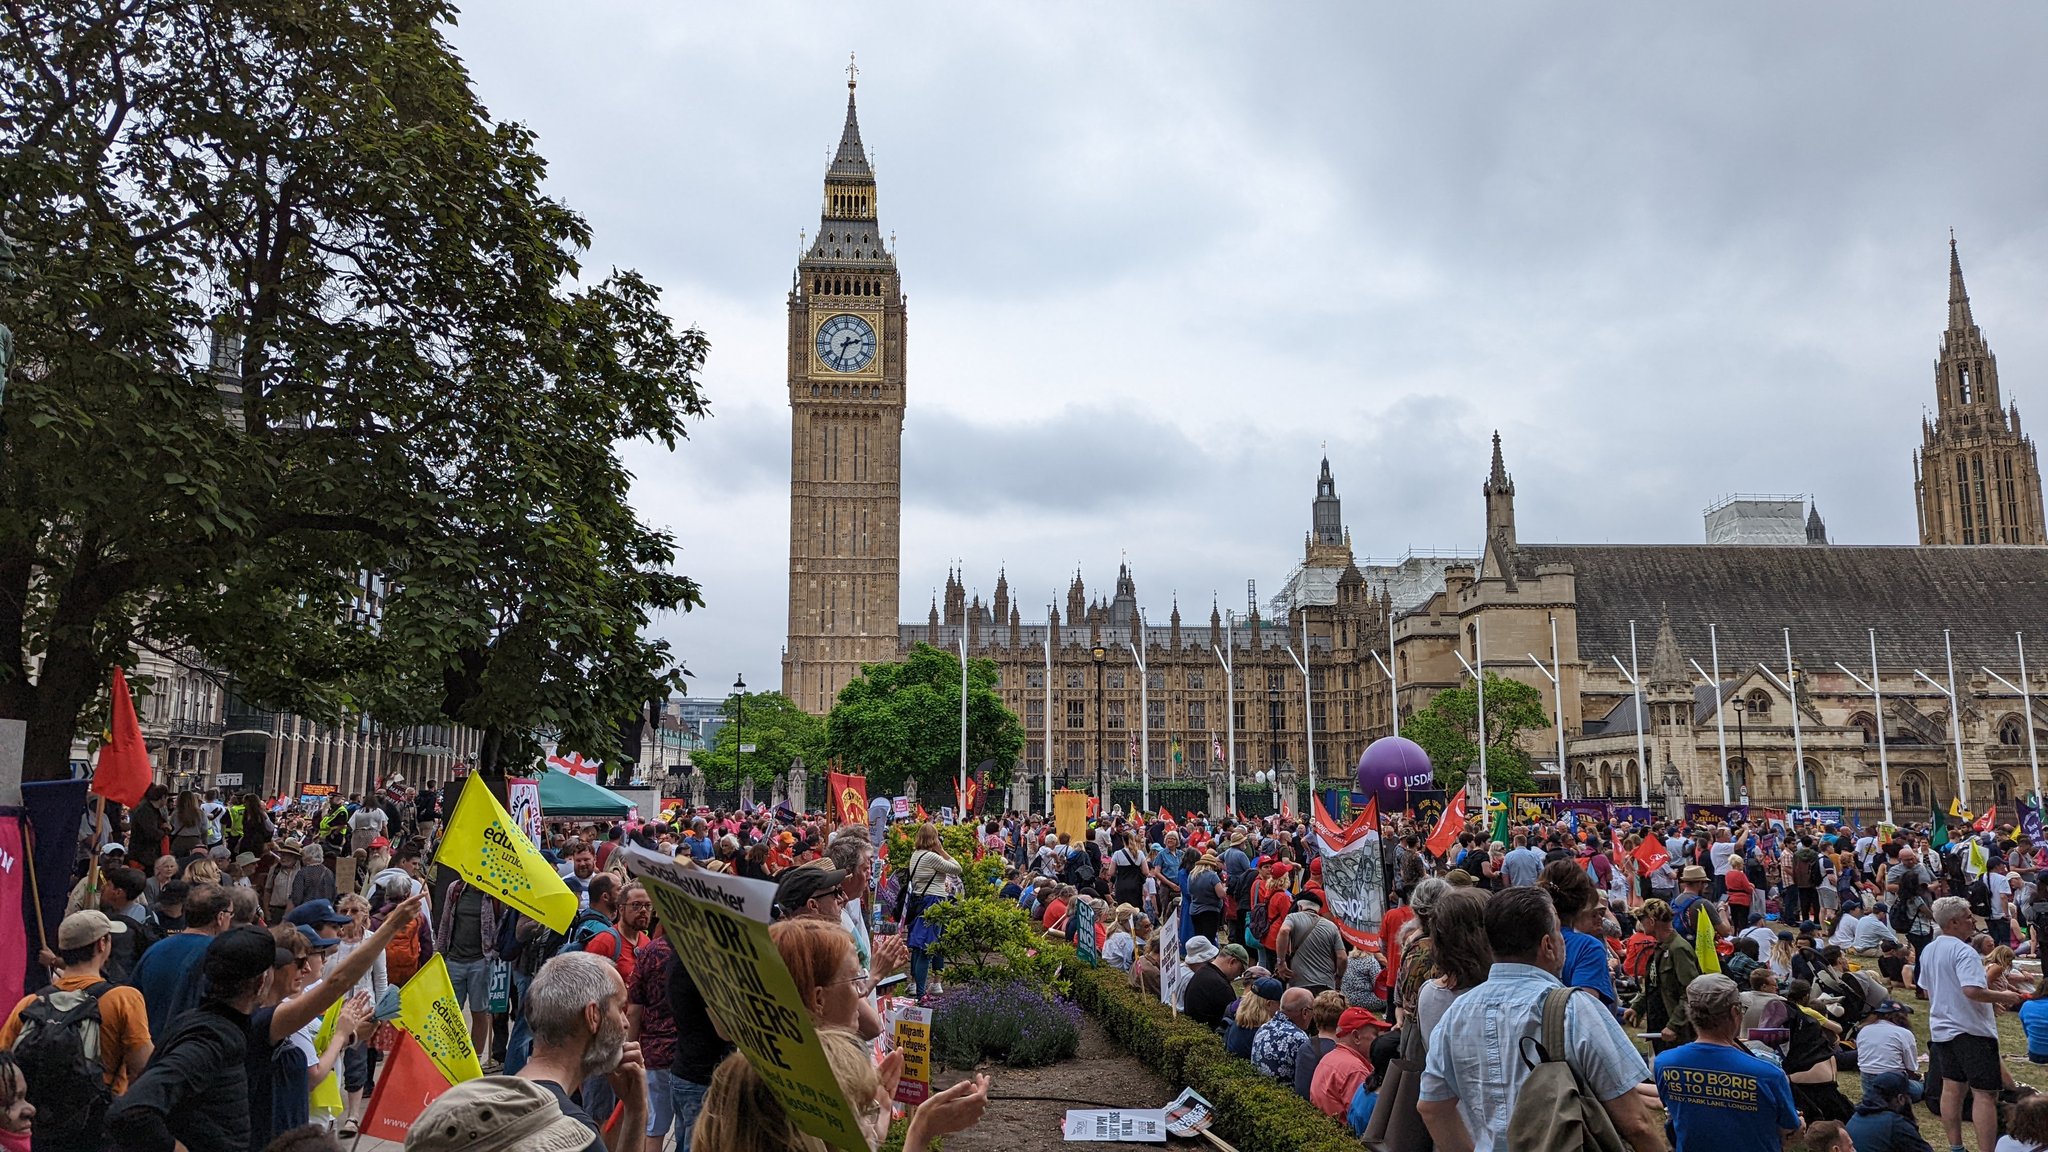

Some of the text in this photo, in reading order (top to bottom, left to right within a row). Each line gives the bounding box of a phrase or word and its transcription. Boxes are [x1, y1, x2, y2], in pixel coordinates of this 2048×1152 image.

[691, 874, 745, 912] Worker
[432, 1000, 472, 1059] education
[440, 1023, 456, 1045] union
[1663, 1069, 1680, 1081] NO
[1683, 1070, 1705, 1084] TO
[1685, 1083, 1702, 1094] TO
[1705, 1086, 1757, 1102] EUROPE
[1728, 1102, 1758, 1112] LONDON
